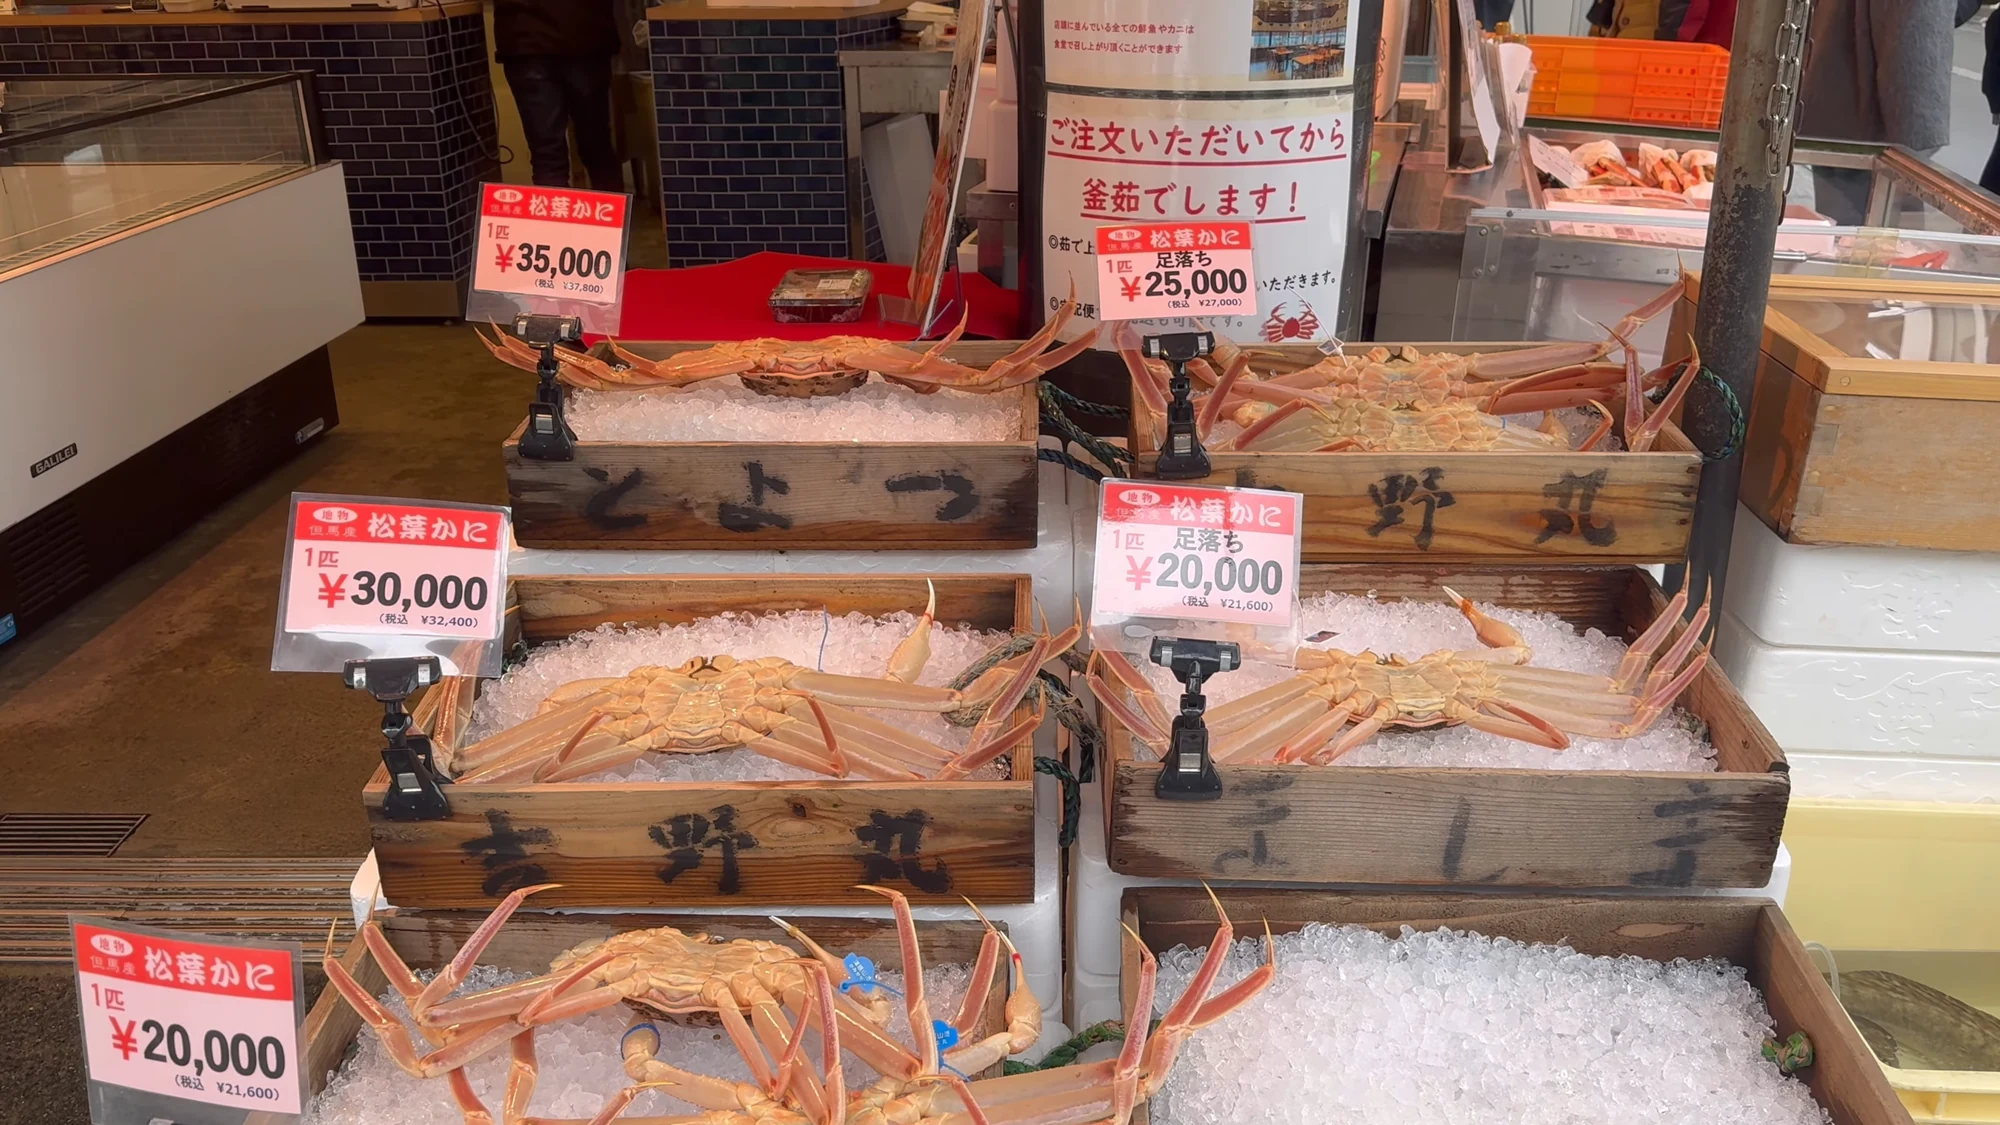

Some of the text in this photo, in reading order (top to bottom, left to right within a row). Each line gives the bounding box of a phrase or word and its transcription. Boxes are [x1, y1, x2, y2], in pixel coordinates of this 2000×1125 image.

[1050, 117, 1345, 156] ご注文いただいてから
[529, 194, 614, 222] 松葉かに
[1082, 177, 1298, 215] 釜茹でします！
[487, 222, 510, 240] 1匹
[1149, 229, 1240, 249] 松葉かに
[495, 243, 612, 279] ¥35,000
[1106, 259, 1133, 274] 1匹
[1156, 250, 1212, 268] 足落ち
[1119, 268, 1248, 302] ¥25,000
[36, 445, 76, 474] GALILEI
[1127, 492, 1153, 504] 地物
[1170, 496, 1282, 527] 松葉かに
[322, 510, 349, 521] 地物
[367, 512, 488, 543] 松葉かに
[308, 525, 358, 538] 但馬産
[1112, 529, 1145, 551] 1匹
[1173, 527, 1244, 553] 足落ち
[304, 547, 339, 568] 1匹
[1126, 553, 1283, 596] ¥20,000
[318, 570, 488, 613] ¥30,000
[99, 938, 126, 954] 地物
[90, 955, 137, 977] 但馬産
[144, 946, 276, 991] 松葉かに
[91, 982, 125, 1012] 1匹
[108, 1015, 286, 1080] ¥20,000
